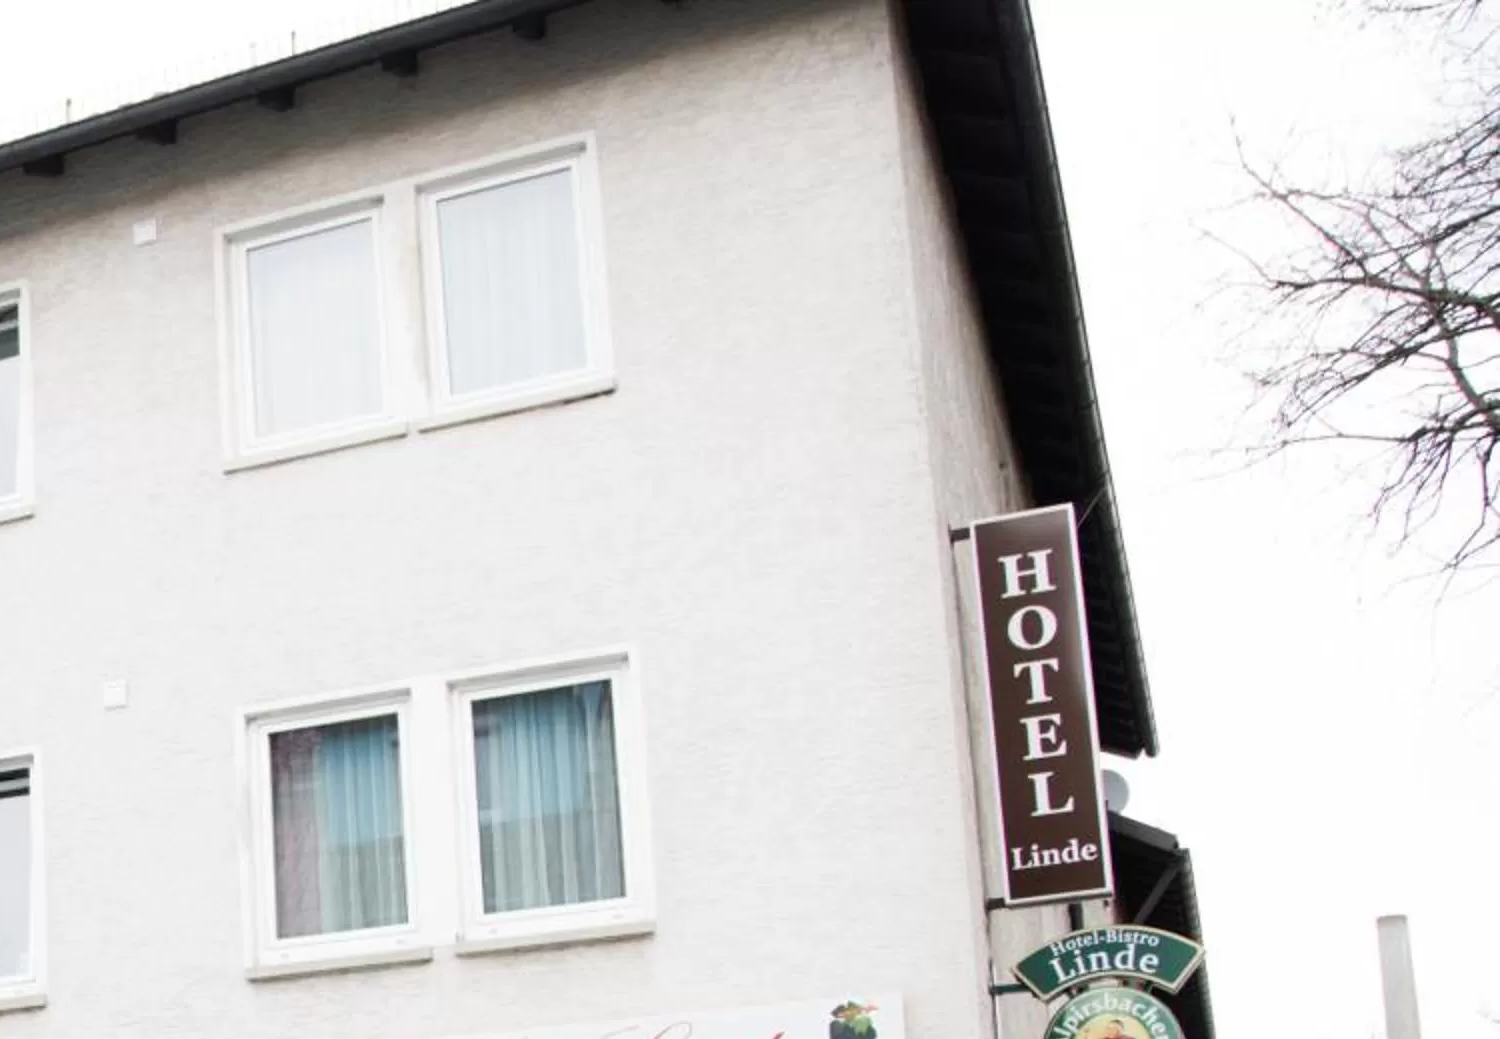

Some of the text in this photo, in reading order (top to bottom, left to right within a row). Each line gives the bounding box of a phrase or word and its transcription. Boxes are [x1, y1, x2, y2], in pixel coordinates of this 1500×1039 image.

[997, 548, 1074, 818] HOTEL
[1011, 838, 1098, 871] Linde
[1051, 928, 1160, 957] Hotel-Bistro
[1049, 943, 1160, 985] Linde
